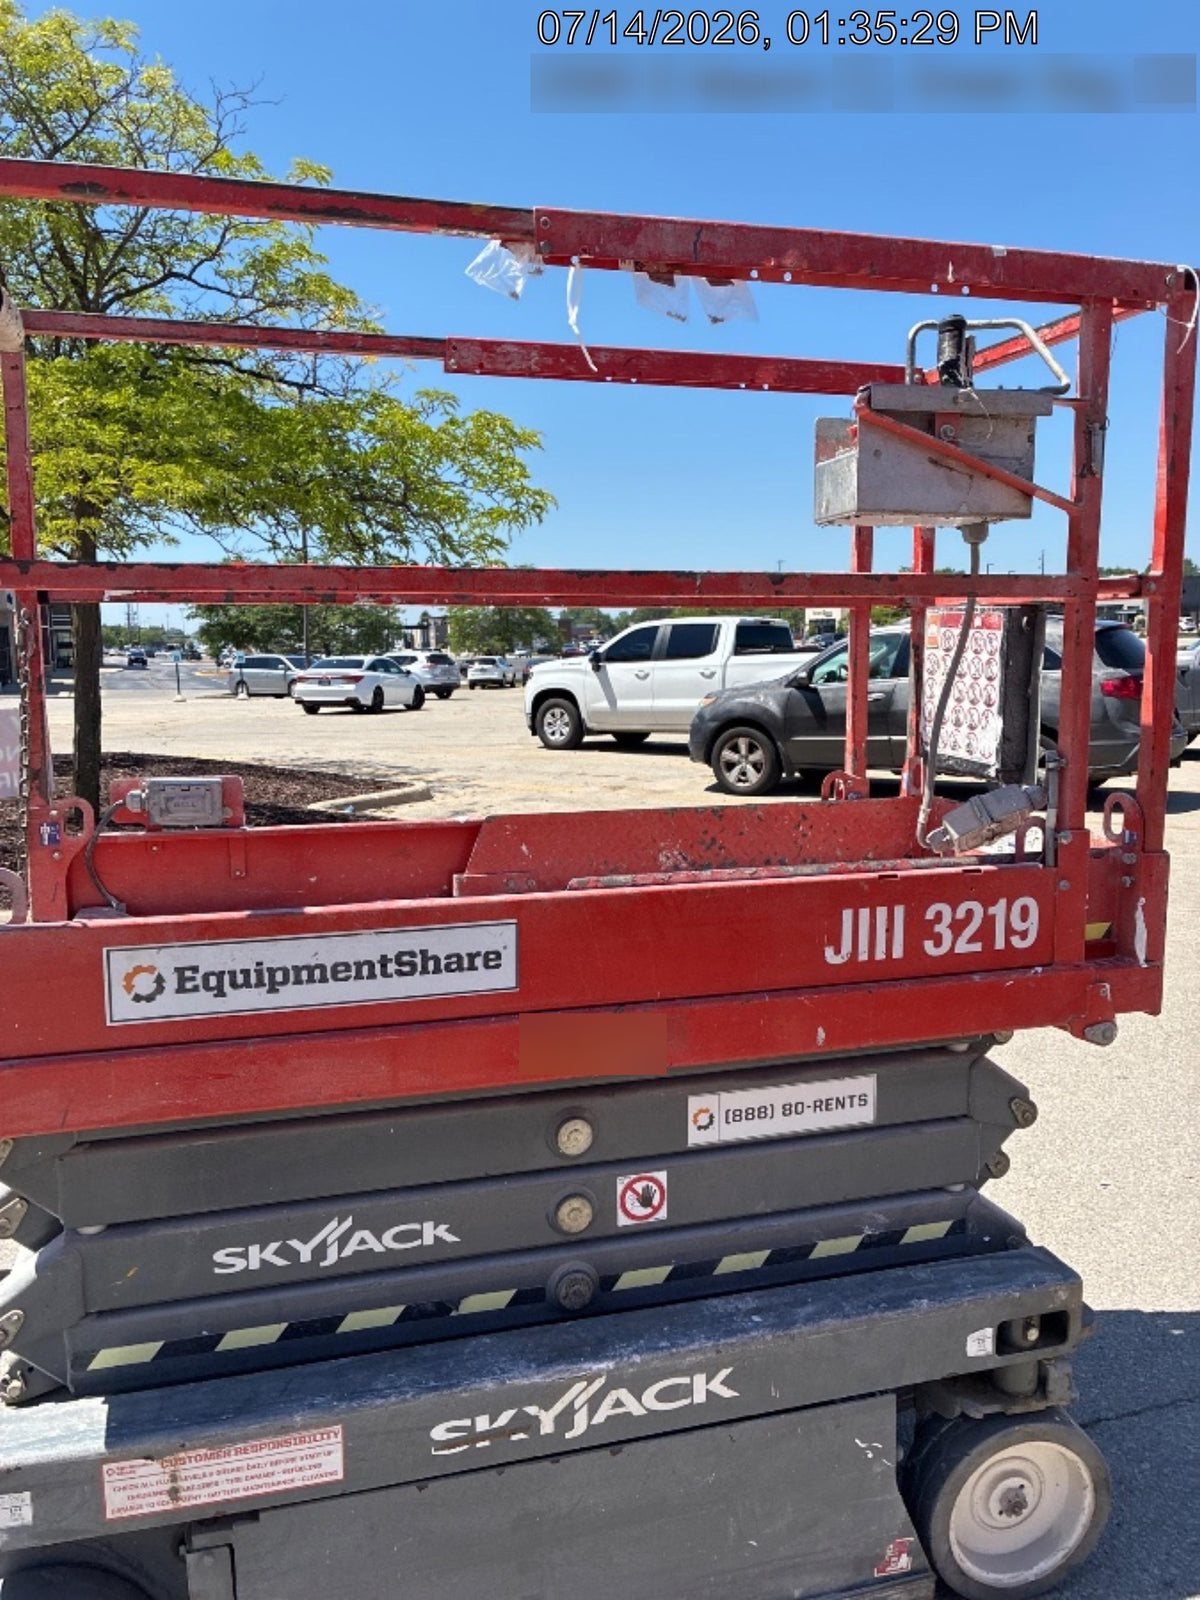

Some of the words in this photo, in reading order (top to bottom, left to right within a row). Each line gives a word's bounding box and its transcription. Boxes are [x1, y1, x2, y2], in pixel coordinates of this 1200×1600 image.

[923, 896, 1040, 957] 3219
[174, 949, 502, 998] EquipmentShare
[725, 1103, 775, 1125] (888)
[781, 1093, 868, 1117] 80-RENTS
[212, 1215, 461, 1274] SKYJACK
[430, 1367, 740, 1455] SKYJACK
[161, 1449, 232, 1469] CUSTOMER
[234, 1430, 340, 1456] RESPONSIBILITY
